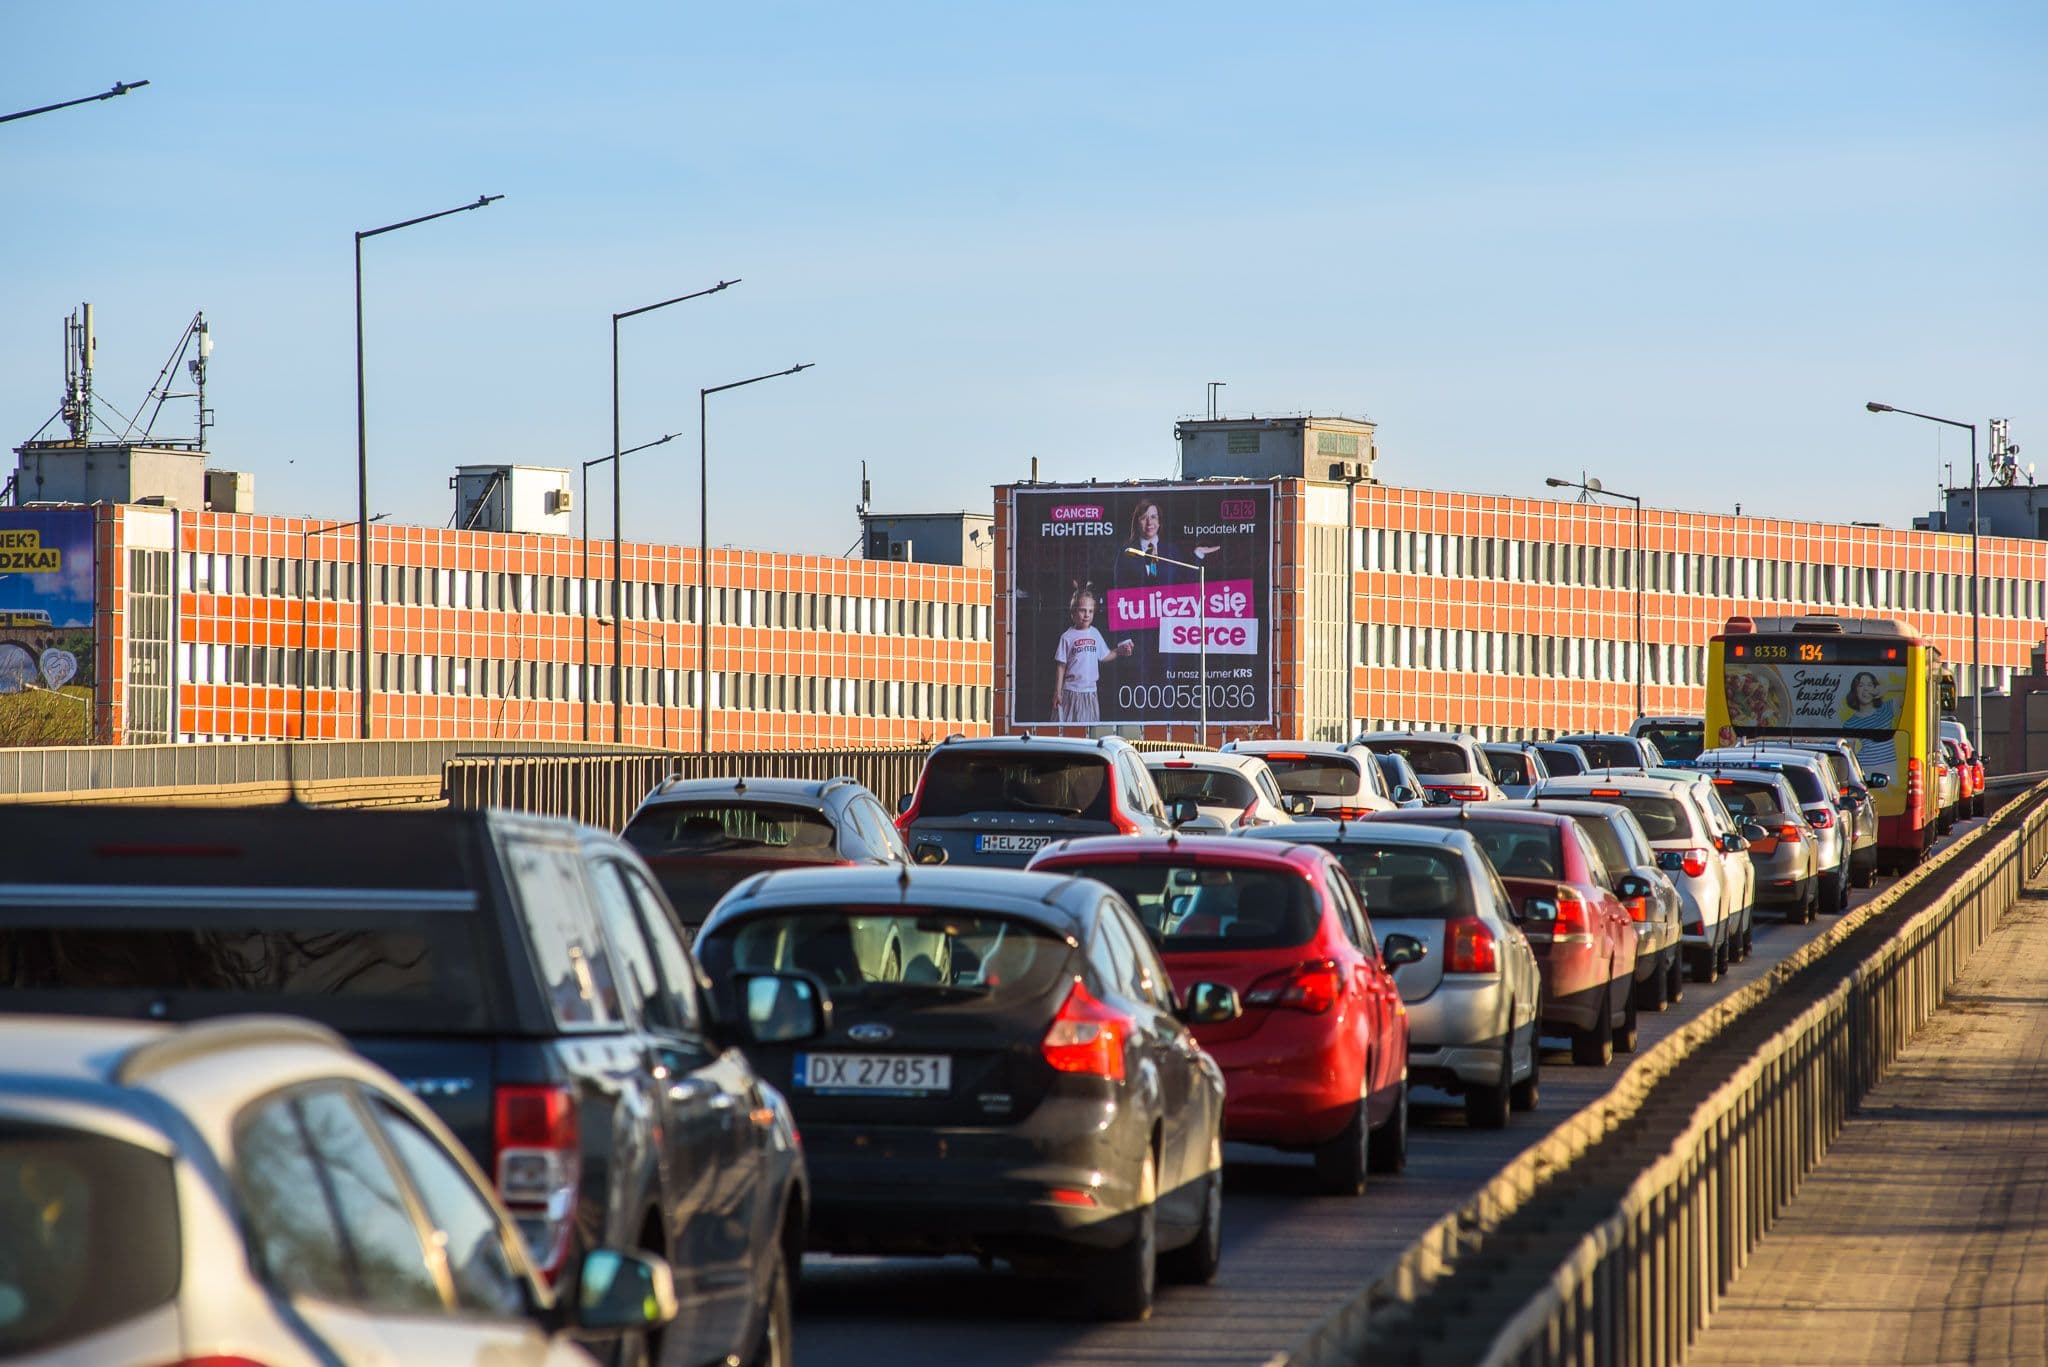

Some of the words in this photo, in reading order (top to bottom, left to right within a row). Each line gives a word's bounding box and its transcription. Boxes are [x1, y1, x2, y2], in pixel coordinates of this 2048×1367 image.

[1055, 507, 1099, 519] CANCER
[1041, 521, 1113, 537] FIGHTERS
[1184, 525, 1194, 536] tu
[1196, 523, 1238, 537] podatek
[1239, 523, 1256, 534] PIT
[1117, 597, 1145, 620] tu
[1149, 590, 1206, 619] liczy
[1209, 586, 1247, 617] się
[1172, 625, 1246, 647] serce
[1754, 645, 1788, 658] 8338
[1799, 643, 1824, 661] 134
[1166, 669, 1176, 679] tu
[1177, 670, 1199, 679] nasz
[1204, 669, 1232, 679] umer
[1233, 668, 1253, 678] KRS
[1793, 670, 1841, 690] Smakuj
[1118, 684, 1256, 709] 0000581036
[1797, 688, 1835, 704] każdą
[1702, 761, 1745, 769] KREW
[811, 1057, 847, 1084] DX
[859, 1058, 941, 1086] 27851
